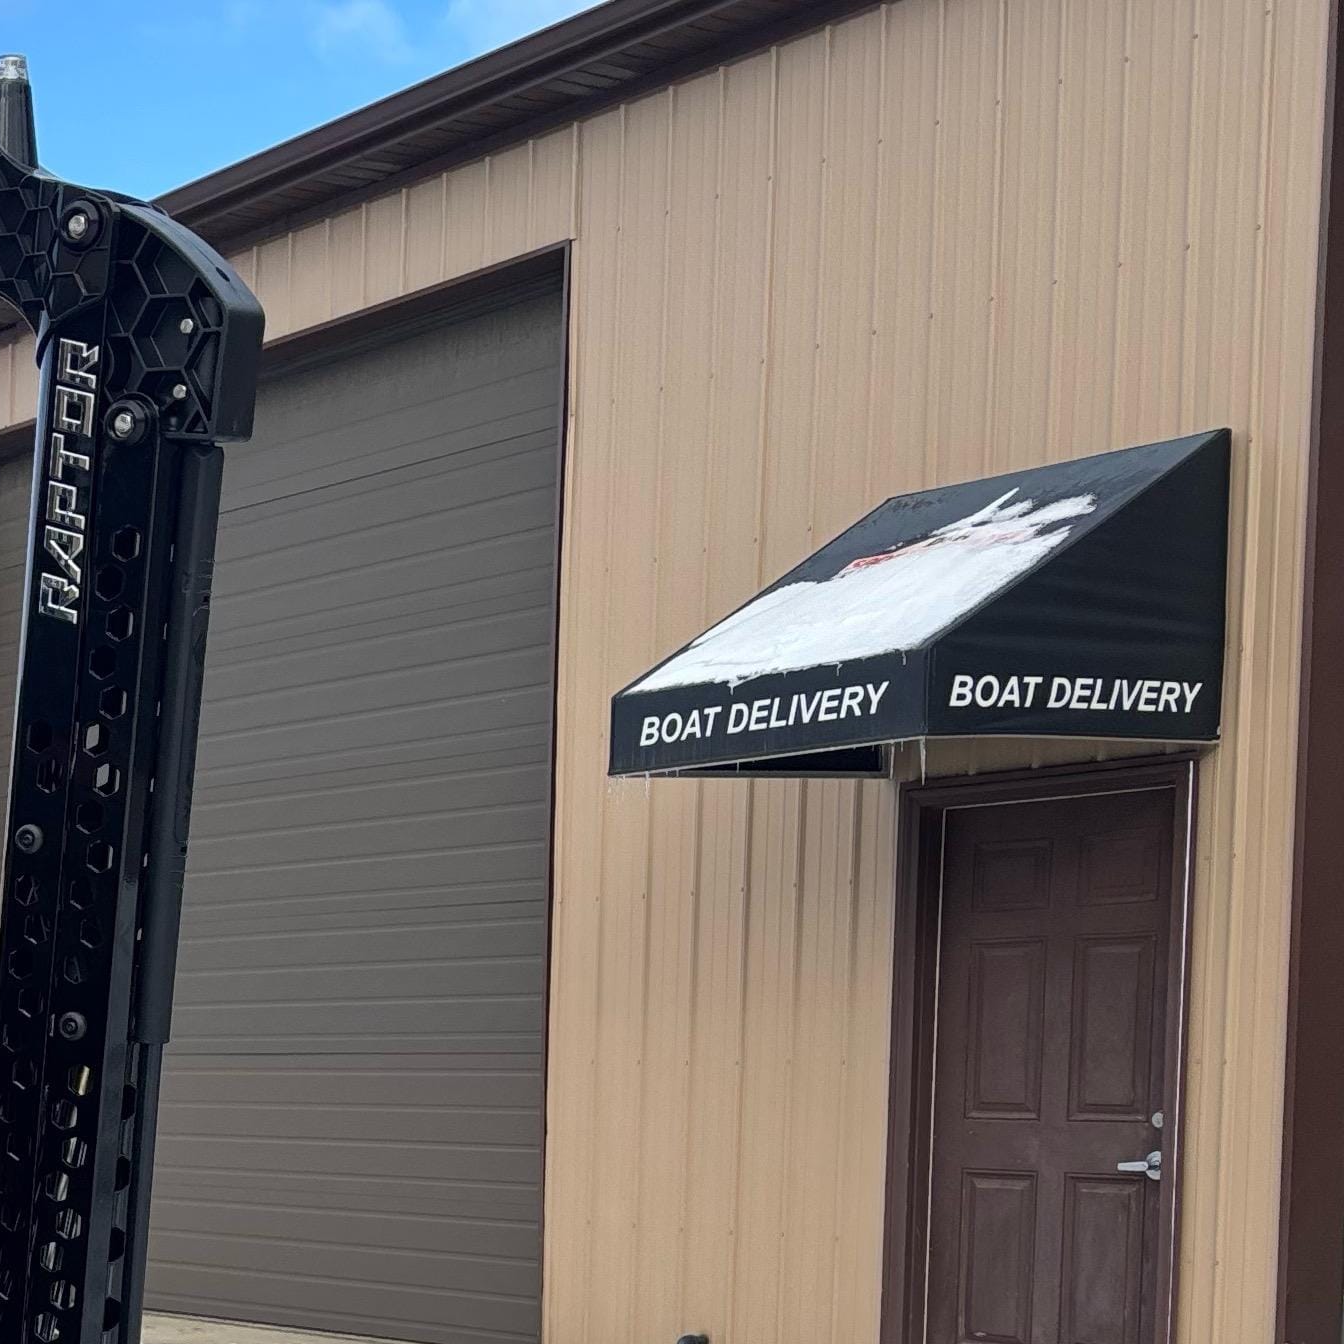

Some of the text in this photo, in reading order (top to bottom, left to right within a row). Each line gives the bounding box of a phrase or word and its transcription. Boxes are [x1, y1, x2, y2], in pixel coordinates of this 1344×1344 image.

[39, 337, 99, 625] RAPTOR
[639, 680, 890, 747] BOAT DELIVERY
[949, 674, 1203, 713] BOAT DELIVERY
